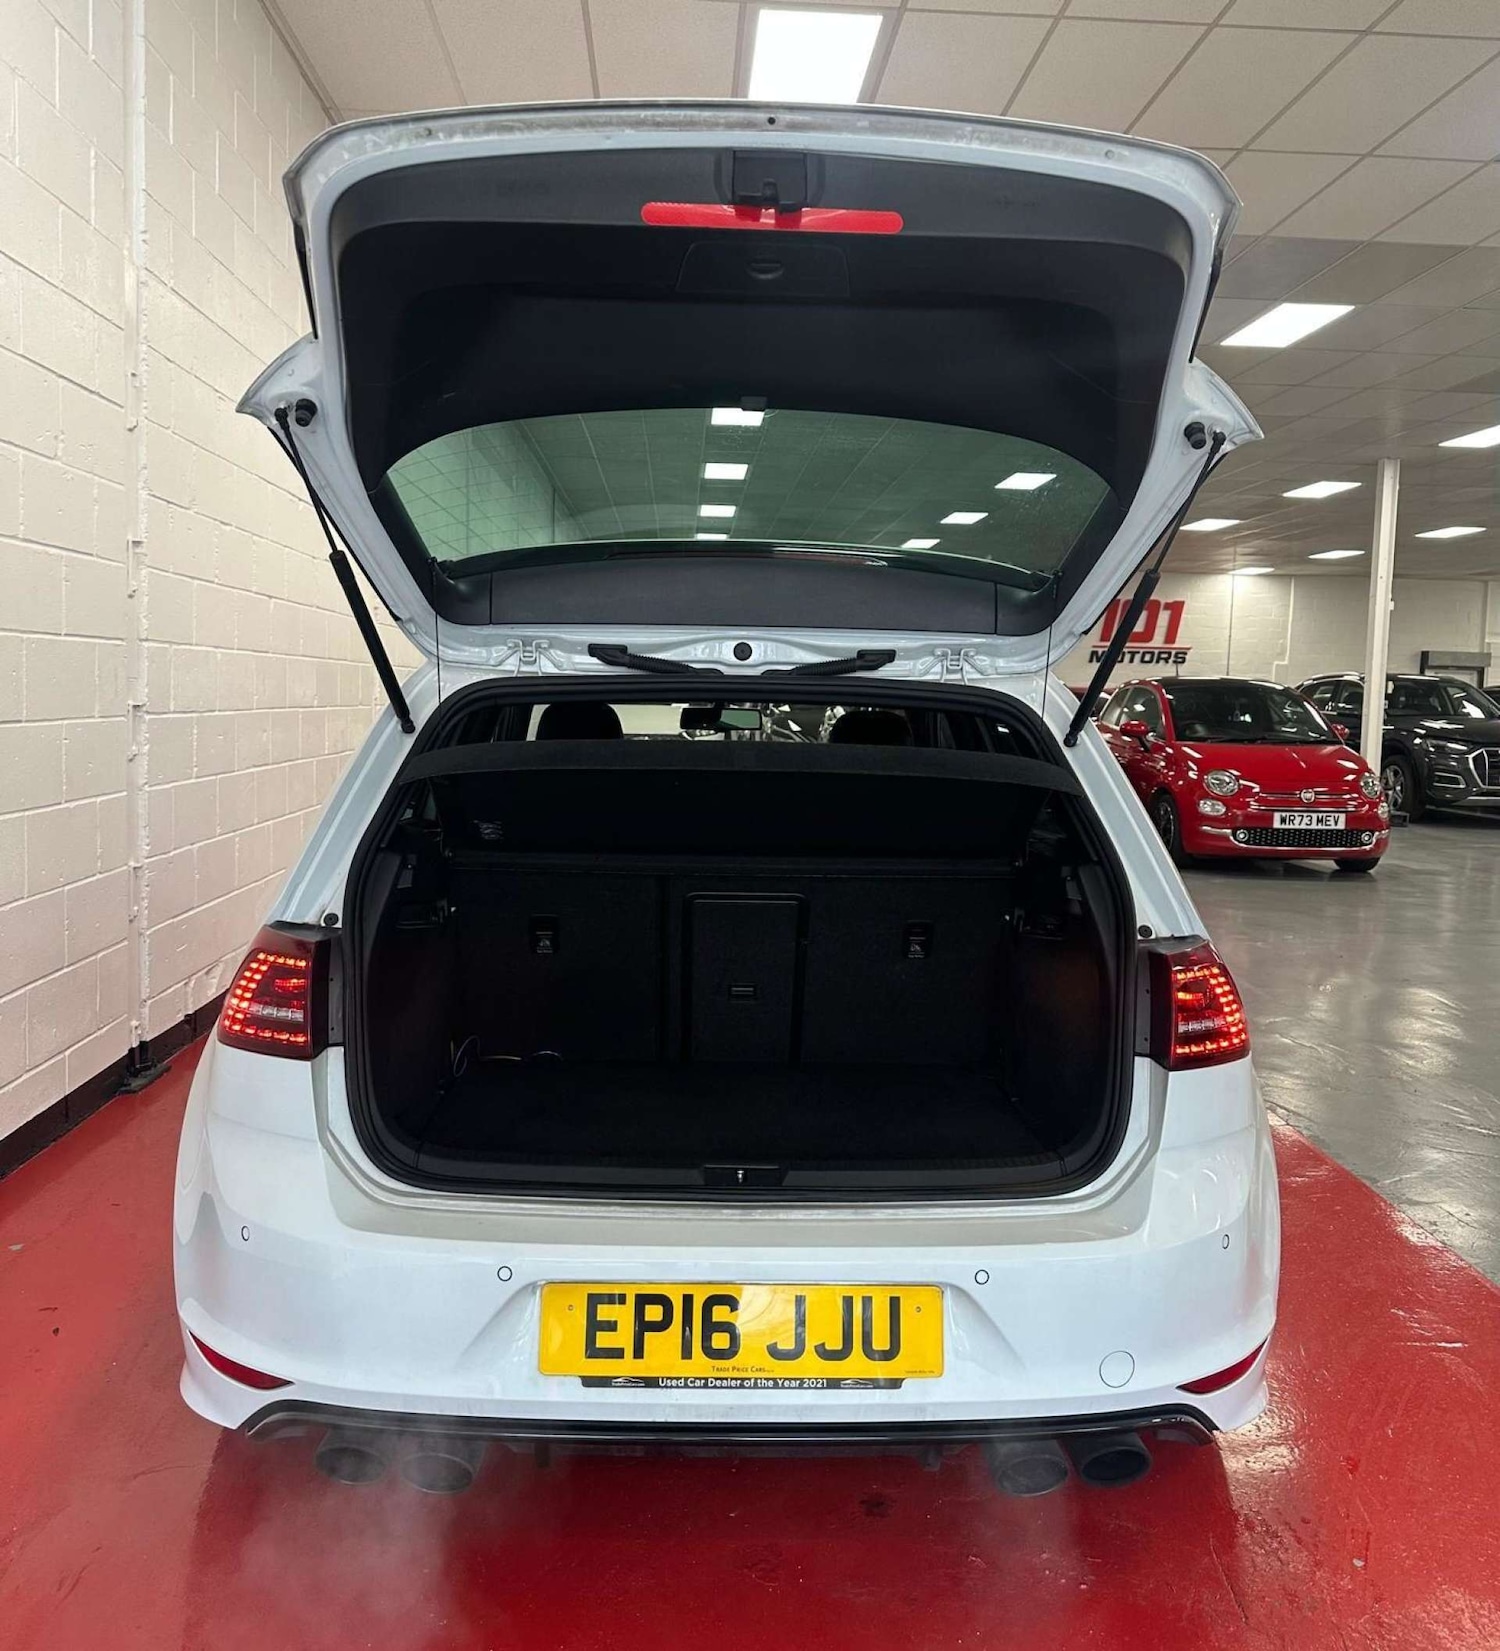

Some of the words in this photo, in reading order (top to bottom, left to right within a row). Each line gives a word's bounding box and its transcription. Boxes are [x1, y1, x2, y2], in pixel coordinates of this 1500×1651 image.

[1099, 598, 1185, 645] 101
[1280, 814, 1313, 826] WR73
[1316, 815, 1340, 827] MEV
[584, 1293, 740, 1361] EP16
[766, 1294, 902, 1362] JJU
[658, 1377, 685, 1387] Used
[687, 1377, 705, 1387] Car
[707, 1377, 741, 1388] Dealer
[743, 1378, 755, 1388] of
[757, 1378, 774, 1388] the
[777, 1379, 801, 1388] Year
[803, 1378, 827, 1388] 2021
